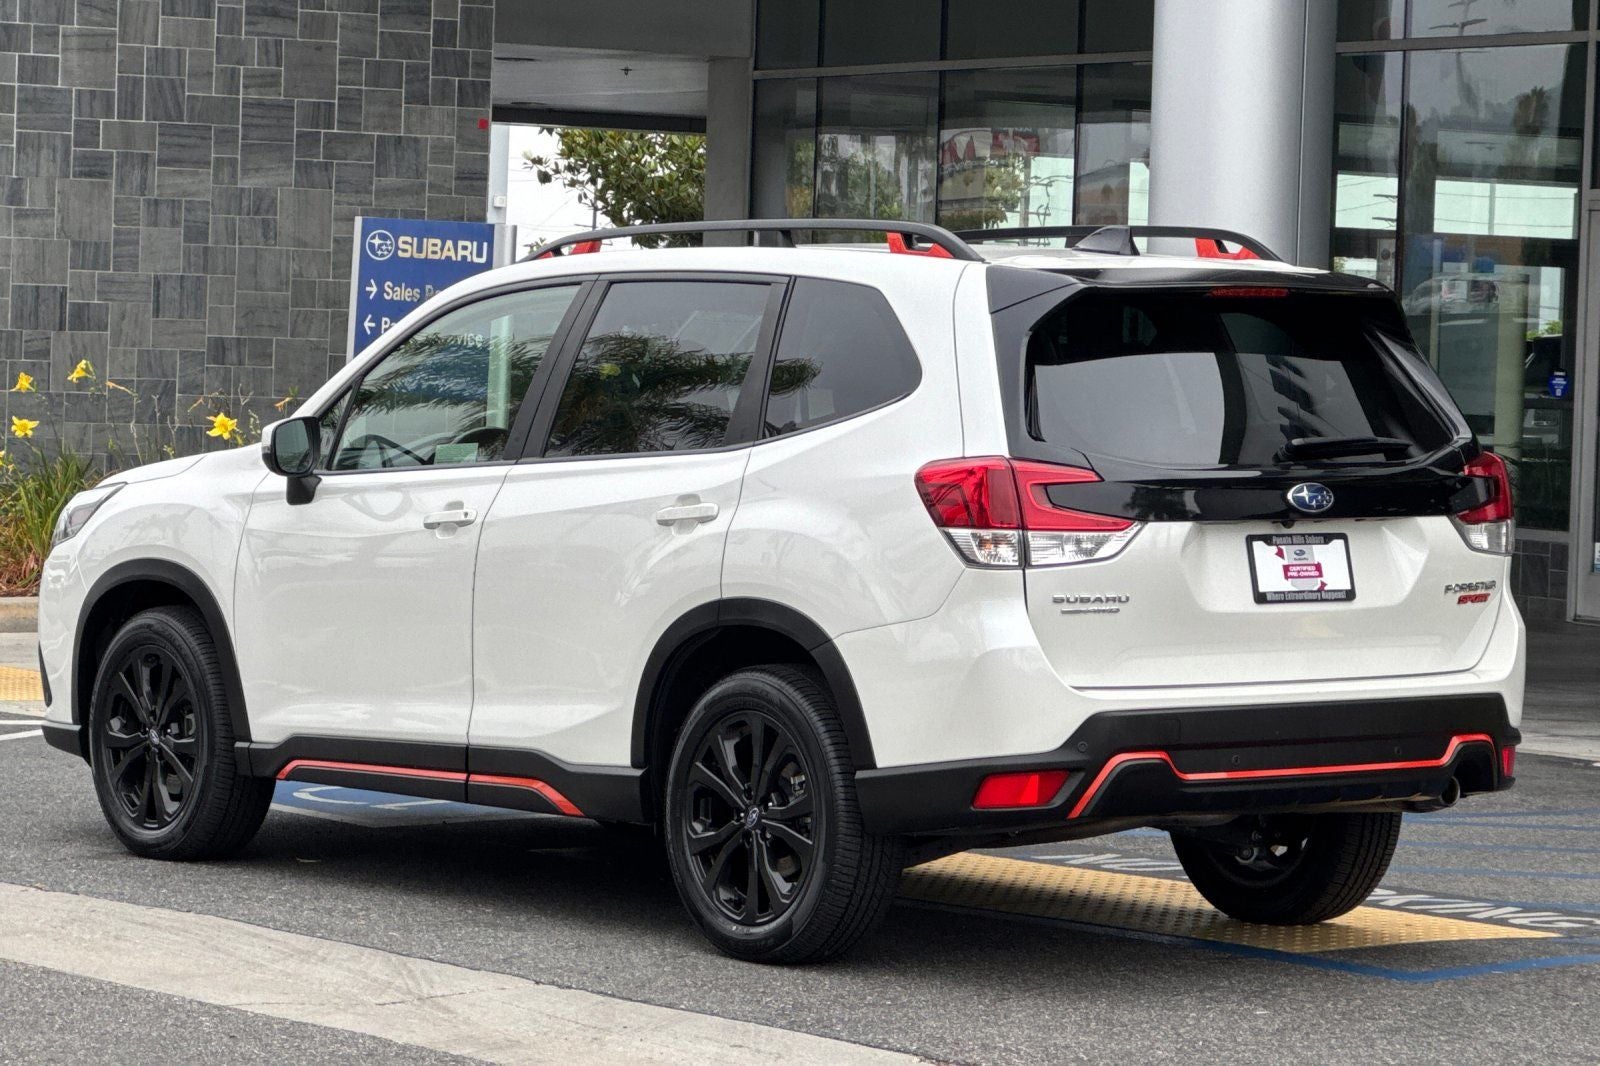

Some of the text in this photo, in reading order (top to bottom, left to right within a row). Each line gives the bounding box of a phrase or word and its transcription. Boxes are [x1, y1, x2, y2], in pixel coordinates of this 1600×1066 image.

[397, 235, 488, 264] SUBARU
[383, 280, 421, 302] Sales
[1444, 580, 1497, 594] FORESTER
[1052, 594, 1130, 604] SUBARU
[1266, 592, 1285, 601] Where
[1457, 593, 1491, 605] SPORT
